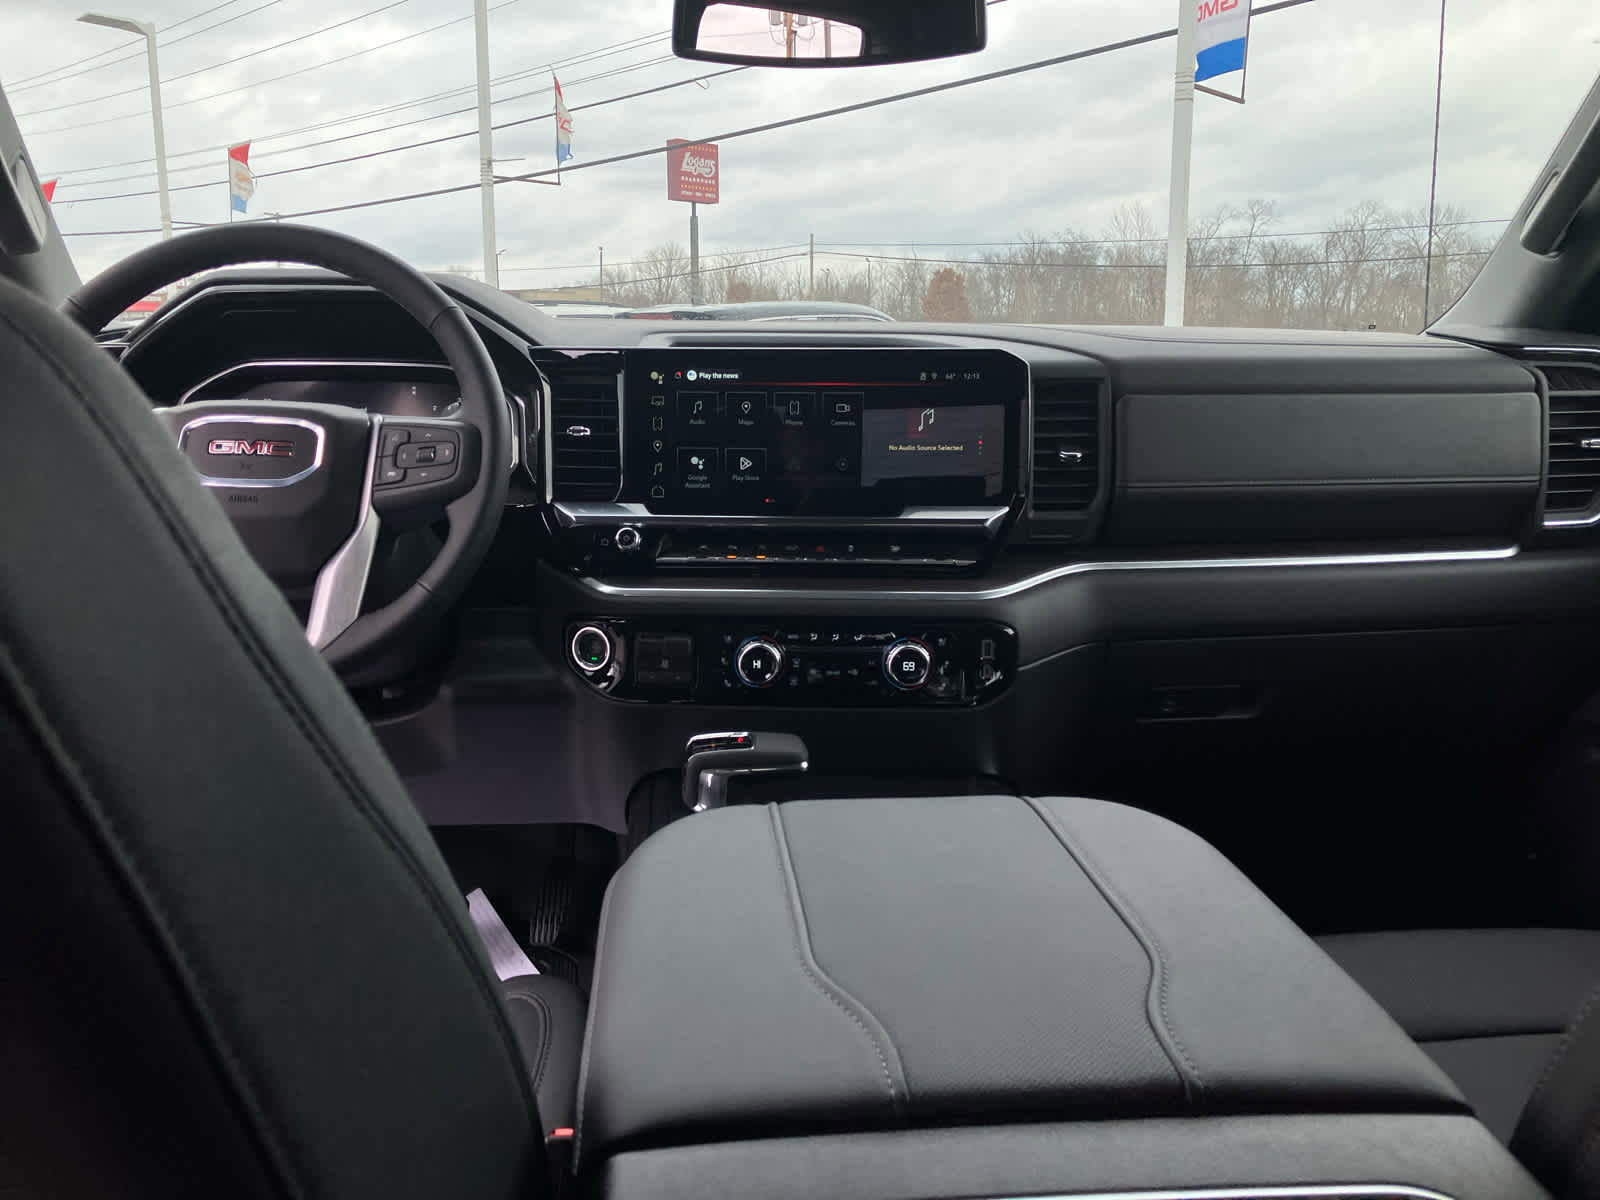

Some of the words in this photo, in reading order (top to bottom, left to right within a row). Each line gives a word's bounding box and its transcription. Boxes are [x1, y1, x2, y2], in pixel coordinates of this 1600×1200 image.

[698, 372, 711, 380] Play
[208, 440, 294, 455] GMC
[902, 661, 916, 672] 69
